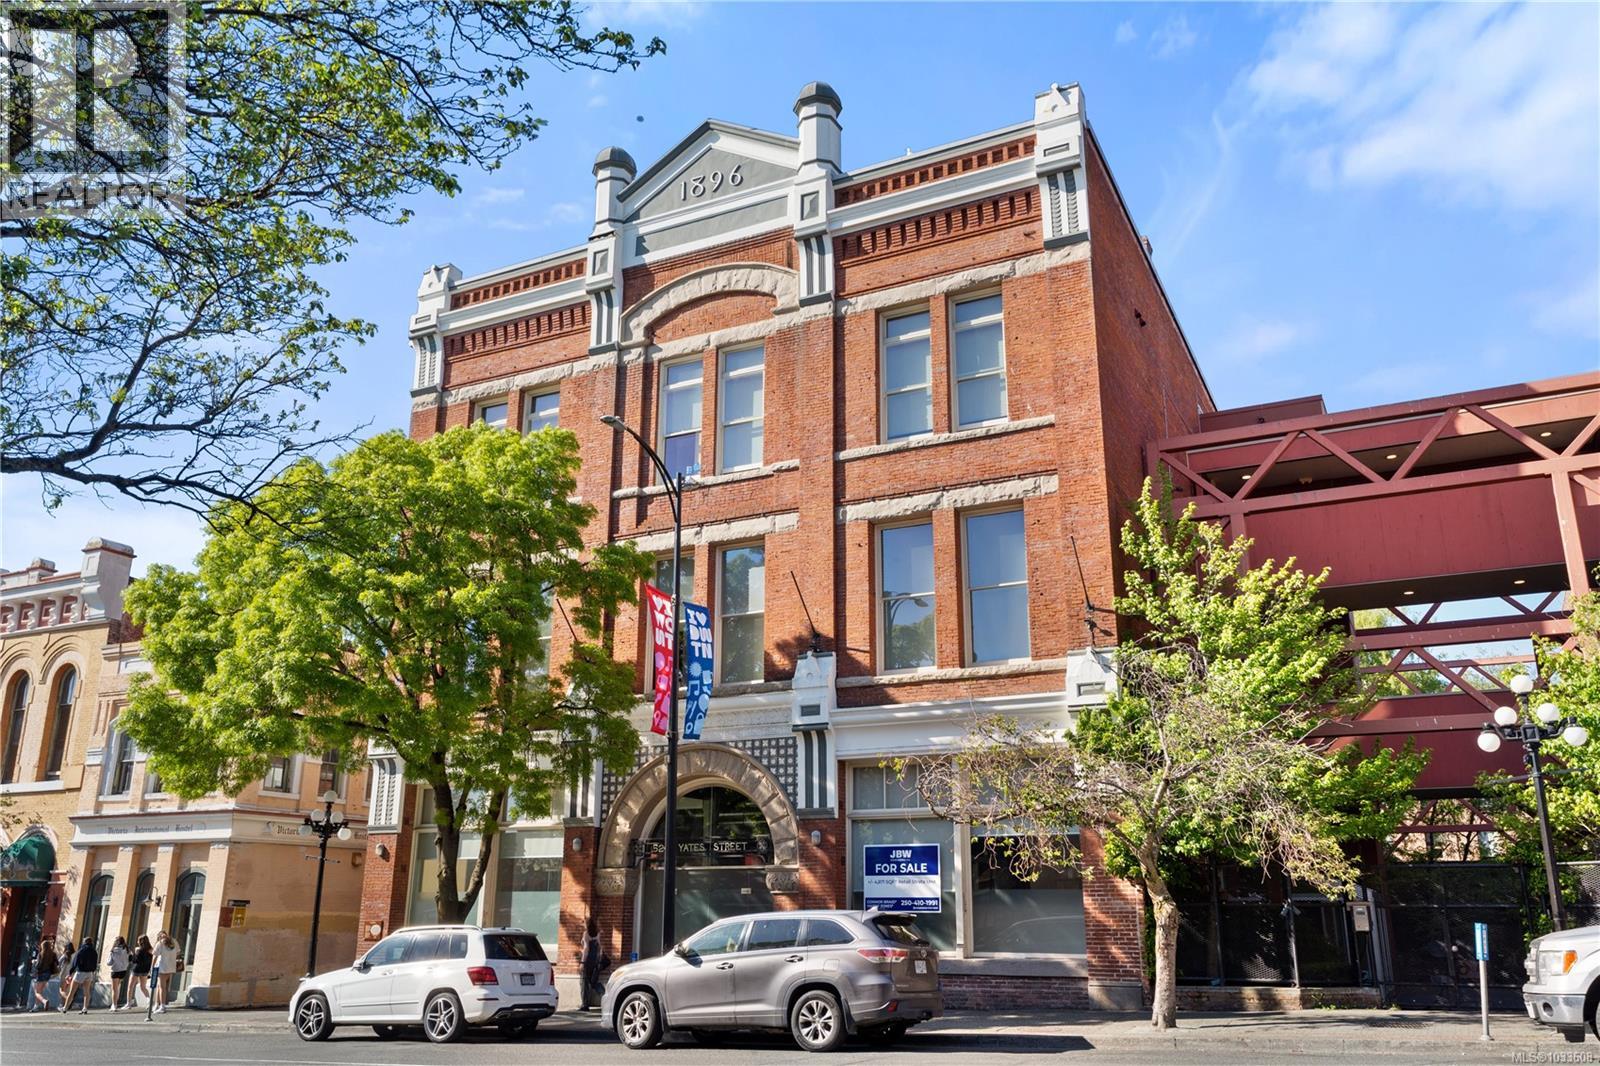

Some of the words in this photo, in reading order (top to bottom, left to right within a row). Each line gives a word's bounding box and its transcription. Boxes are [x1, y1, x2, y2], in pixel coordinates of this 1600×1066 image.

[681, 164, 744, 201] 1896
[652, 843, 666, 853] 52
[678, 843, 706, 853] YATES
[713, 842, 747, 852] STREET
[889, 850, 912, 858] JBW
[875, 863, 897, 874] FOR
[900, 862, 928, 873] SALE
